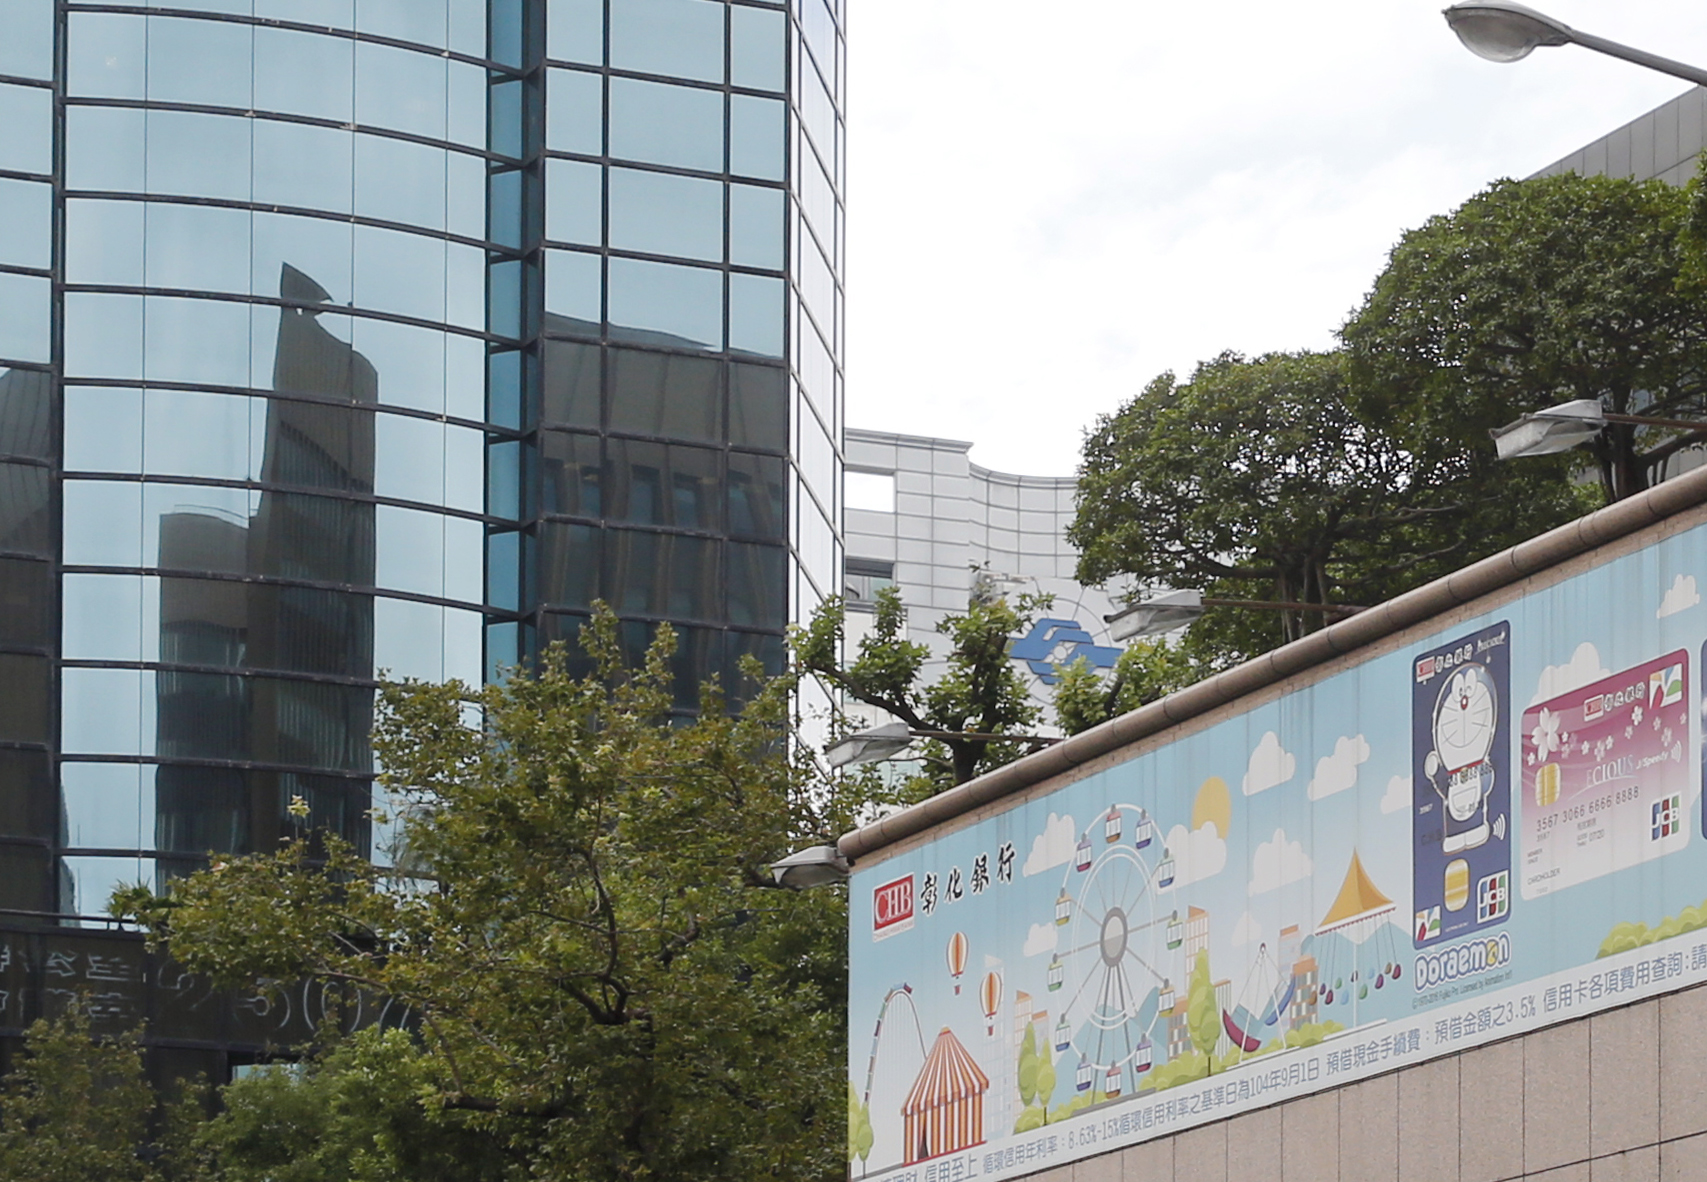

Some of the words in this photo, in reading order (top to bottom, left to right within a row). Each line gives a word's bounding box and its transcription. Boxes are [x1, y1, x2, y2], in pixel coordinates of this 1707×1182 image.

[1651, 808, 1680, 829] JCB
[875, 881, 912, 924] CHB
[920, 843, 1015, 914] 彰化銀行
[1415, 933, 1511, 991] Doraemon
